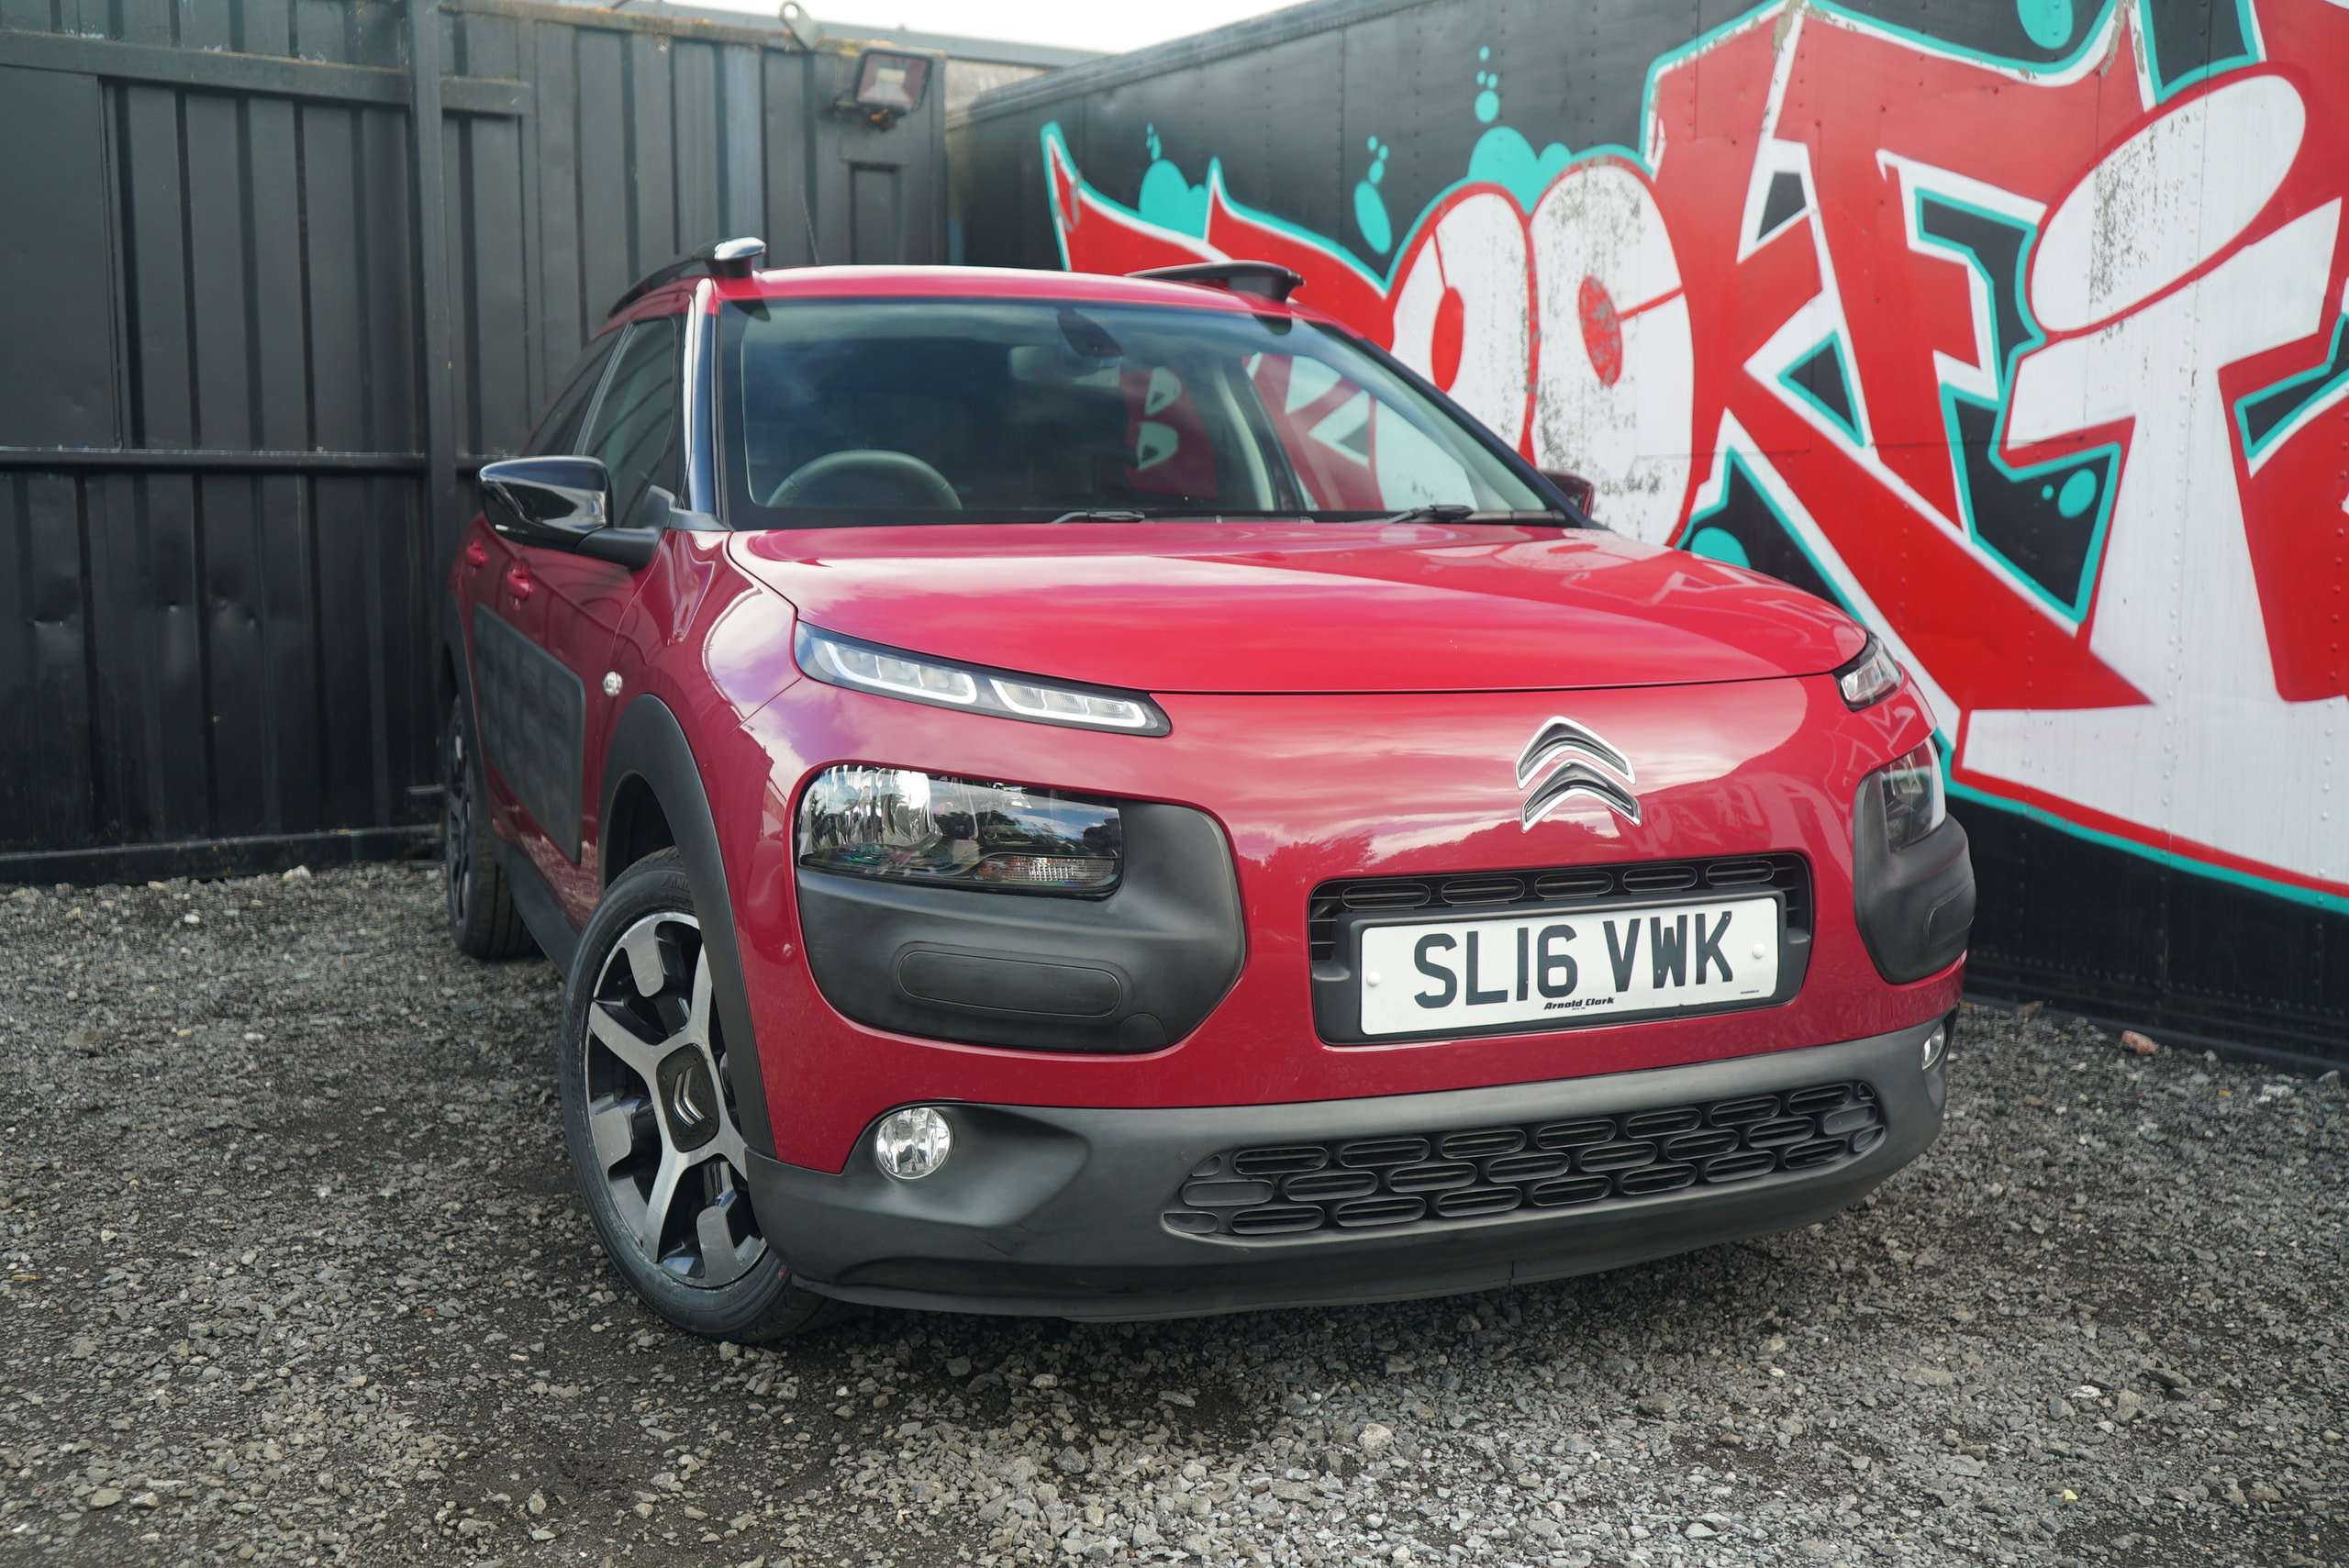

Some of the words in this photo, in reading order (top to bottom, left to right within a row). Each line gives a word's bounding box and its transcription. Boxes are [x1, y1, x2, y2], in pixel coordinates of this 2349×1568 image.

[1413, 924, 1578, 1009] SL16
[1602, 910, 1733, 993] VWK
[1543, 999, 1584, 1010] Arnold
[1585, 996, 1615, 1006] Clark
